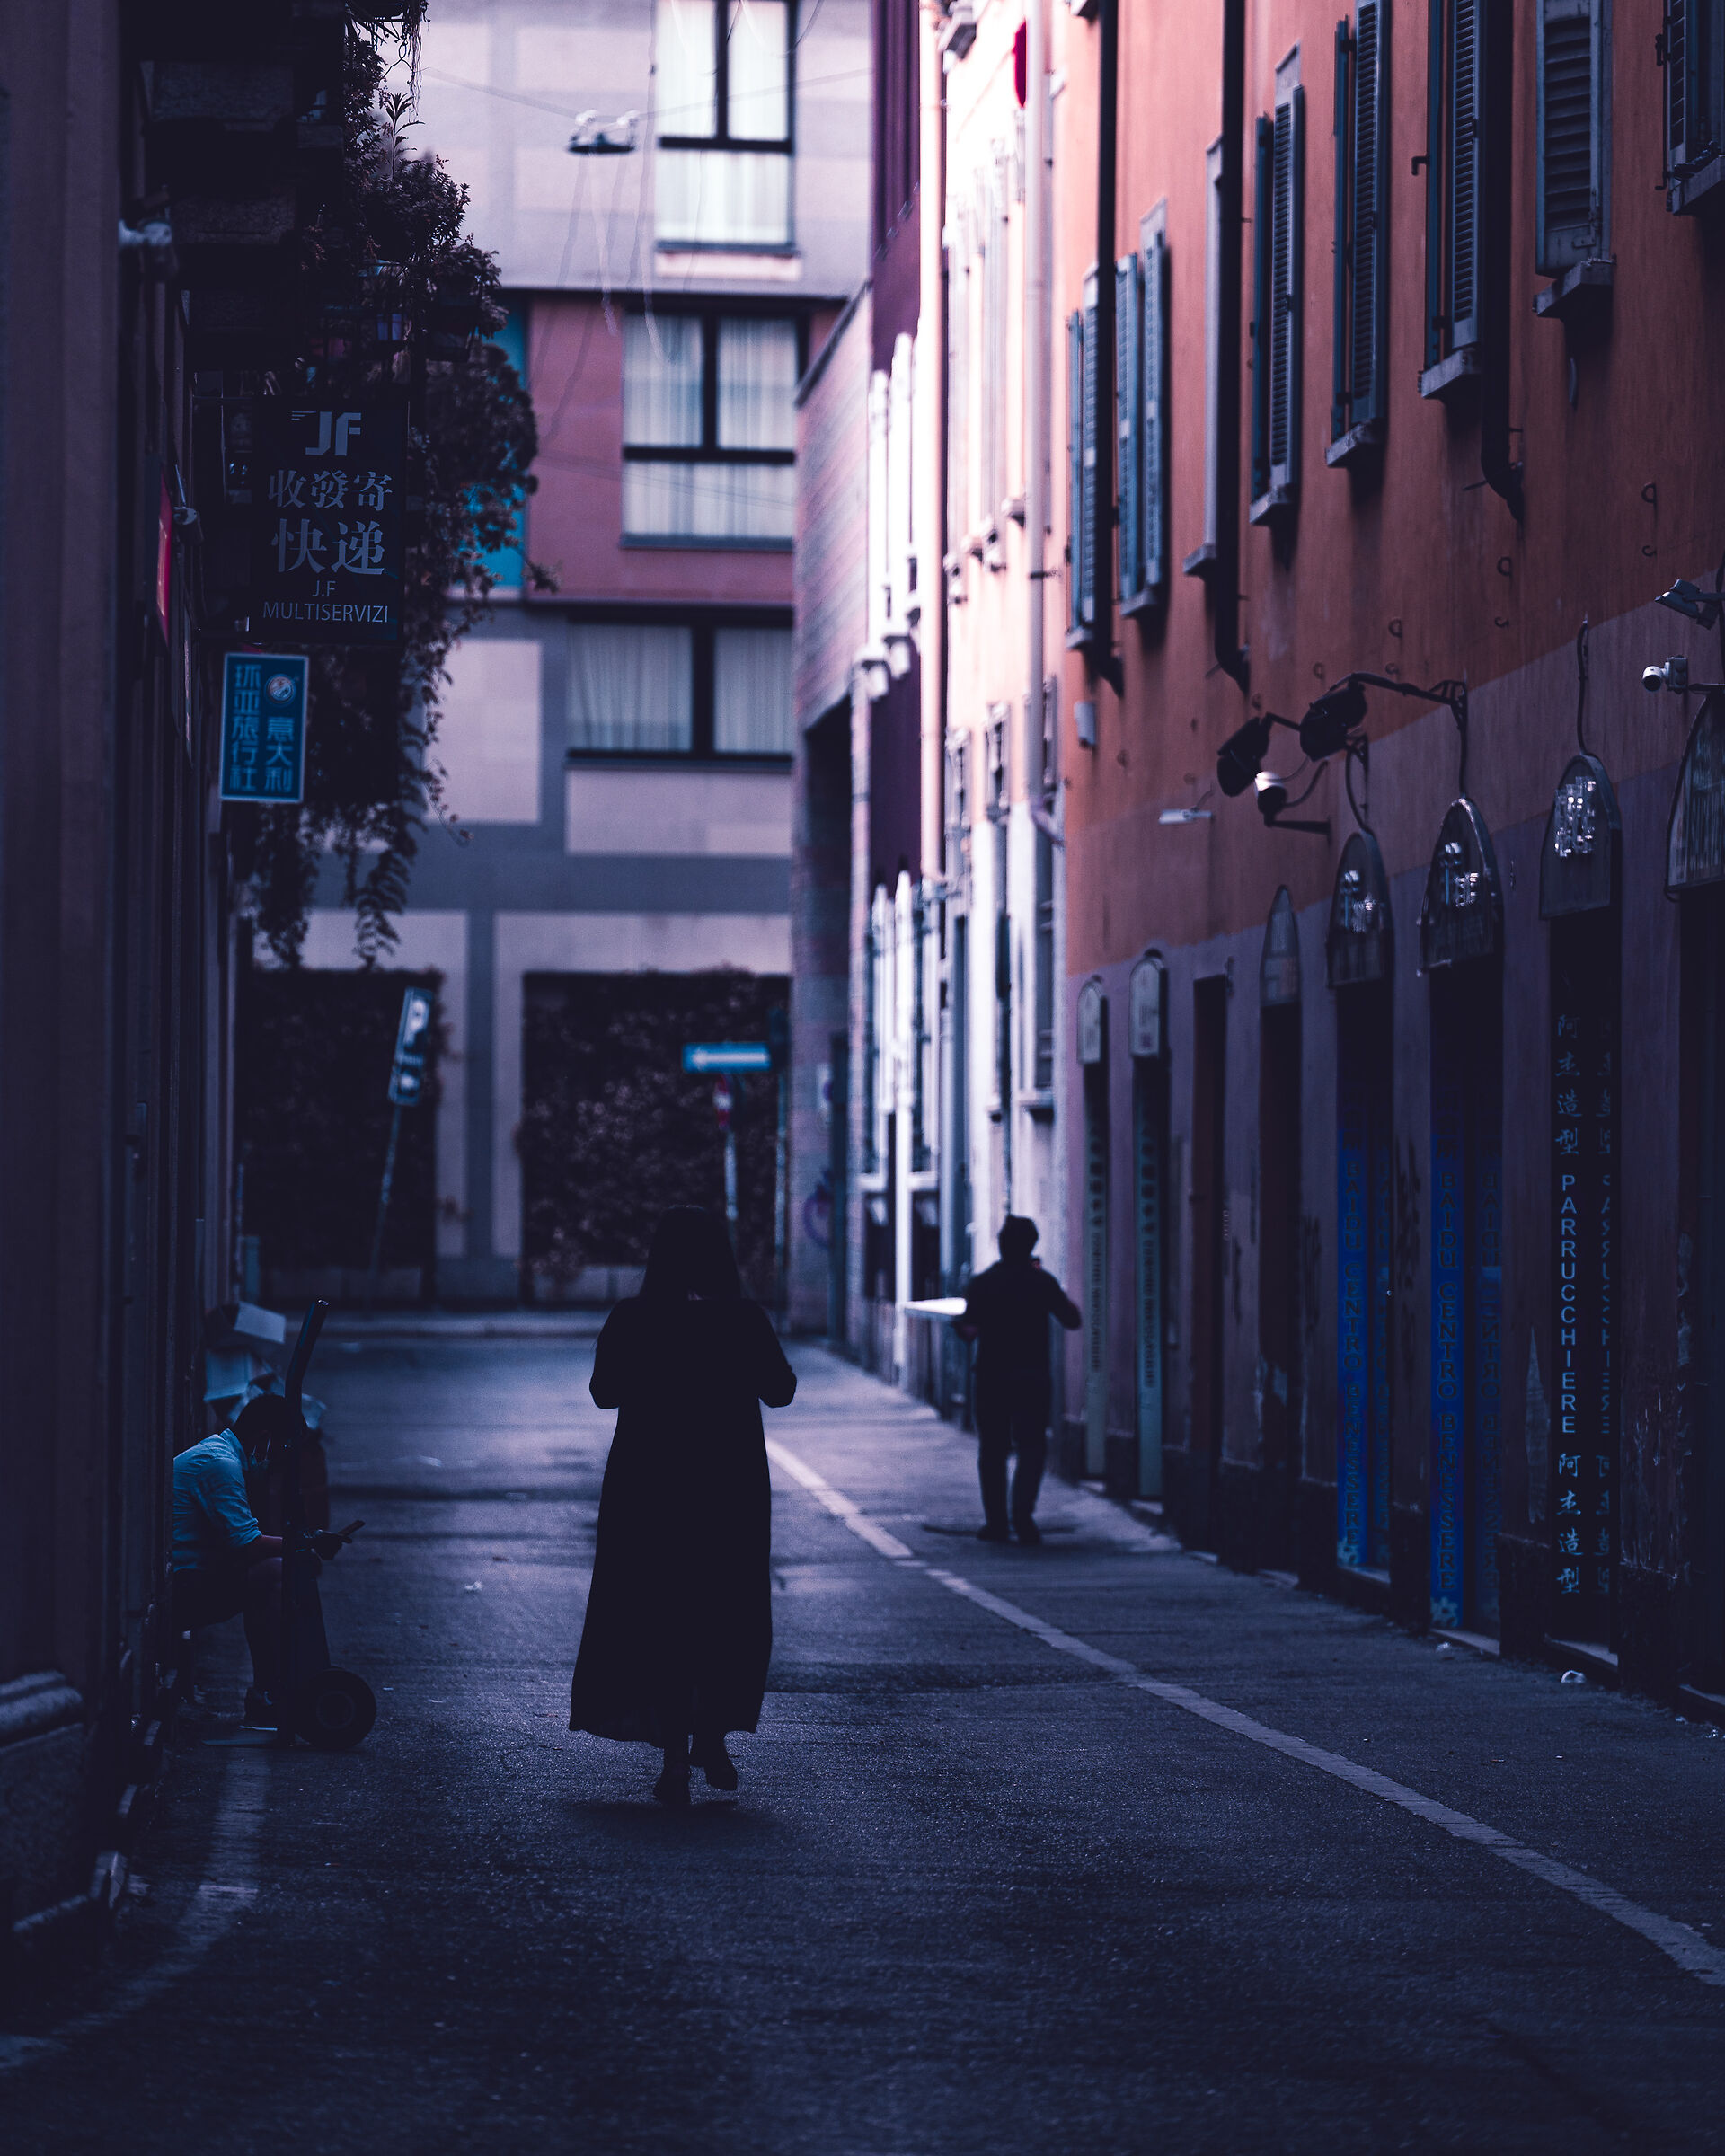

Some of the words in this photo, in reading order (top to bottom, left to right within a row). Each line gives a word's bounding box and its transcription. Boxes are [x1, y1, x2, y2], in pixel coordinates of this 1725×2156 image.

[268, 469, 393, 512] 收發寄
[270, 517, 386, 577] 快递
[311, 579, 337, 598] J.F
[262, 602, 389, 623] MULTISERVIZI
[230, 663, 261, 791] 环亚旅行社
[264, 716, 295, 792] 意大利
[1345, 1160, 1362, 1250] BAIDU
[1438, 1171, 1458, 1268] BAIDU
[1344, 1263, 1362, 1371] CENTRO
[1438, 1283, 1458, 1400] CENTRO
[1561, 1174, 1578, 1434] PARRUCCHIERE
[1438, 1414, 1456, 1590] BENESSERE
